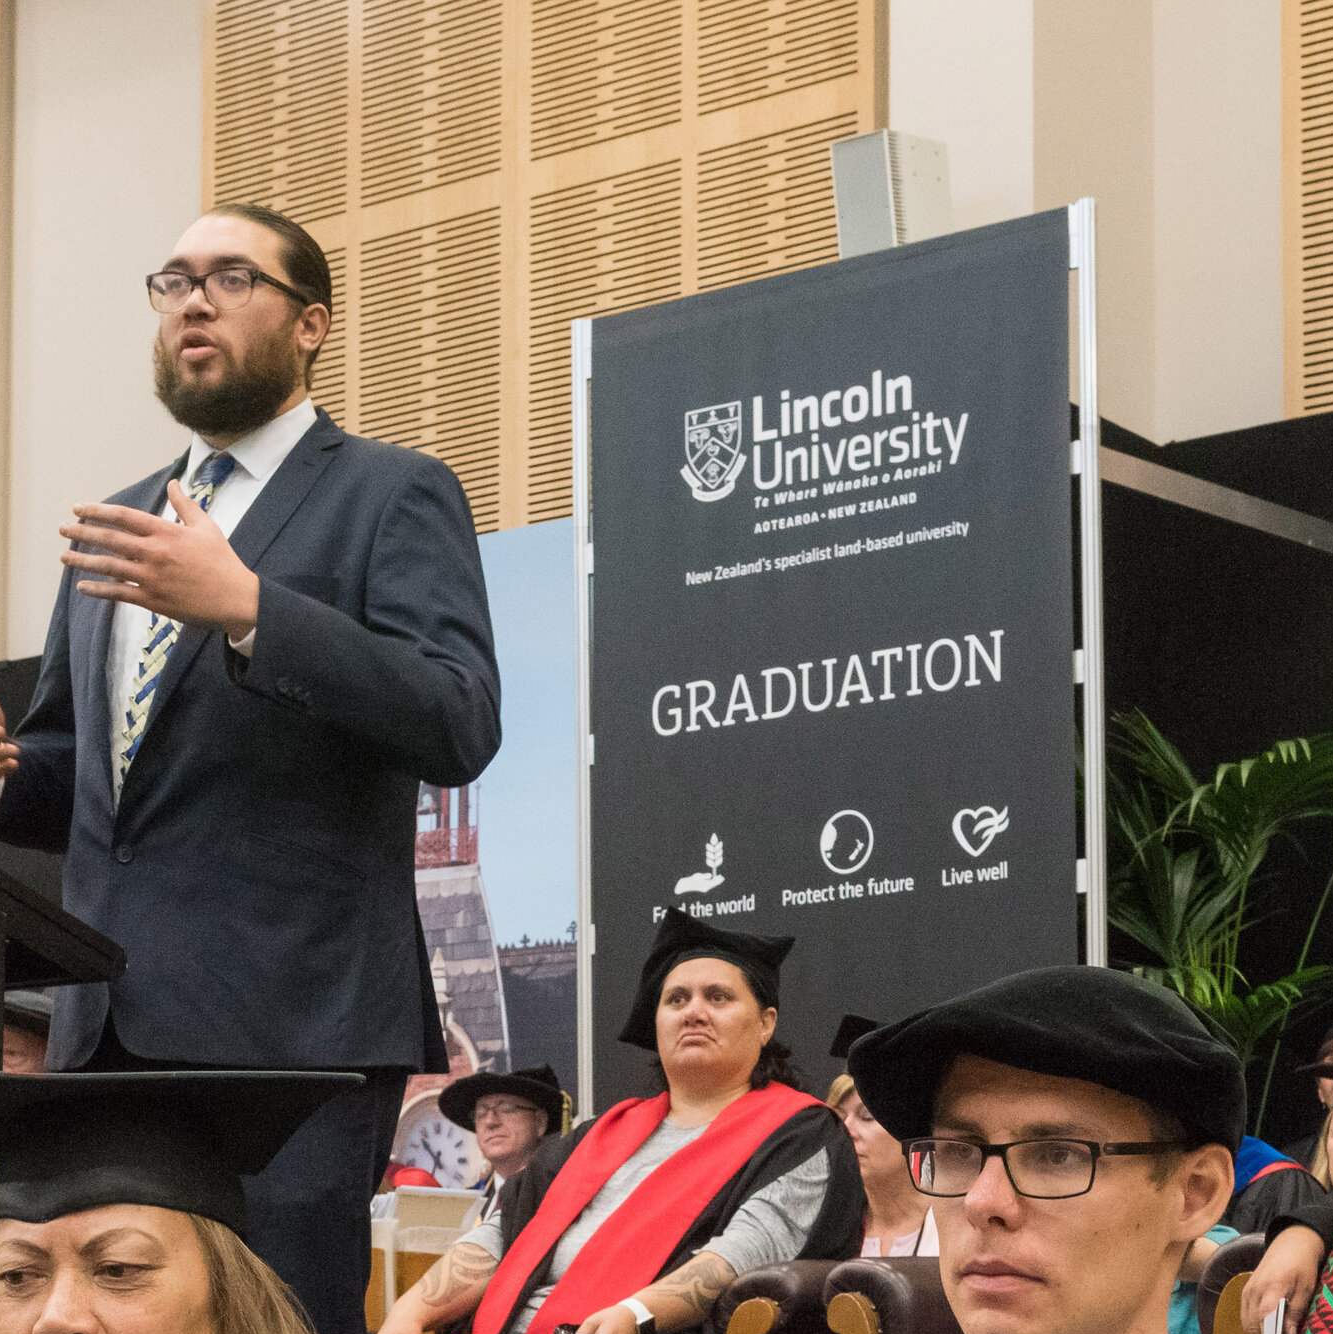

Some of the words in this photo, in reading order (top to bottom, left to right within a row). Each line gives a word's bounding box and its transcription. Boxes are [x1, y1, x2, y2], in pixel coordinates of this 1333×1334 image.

[752, 369, 913, 443] Lincoln
[753, 411, 969, 491] University
[754, 496, 769, 509] Te
[774, 487, 818, 505] Whare
[881, 472, 891, 483] o
[893, 460, 942, 482] Aoraki
[754, 511, 820, 534] AOTEAROA
[828, 504, 857, 520] NEW
[860, 492, 917, 514] ZEALAND
[686, 570, 713, 586] New
[715, 557, 772, 581] Zealand's
[774, 545, 832, 571] specialist
[834, 531, 904, 559] land-based
[906, 521, 970, 545] university
[652, 629, 1004, 736] GRADUATION
[782, 885, 835, 906] Protect
[838, 880, 864, 899] the
[867, 874, 915, 894] future
[941, 868, 973, 887] Live
[976, 861, 1008, 882] well
[689, 900, 713, 918] the
[716, 894, 756, 915] world
